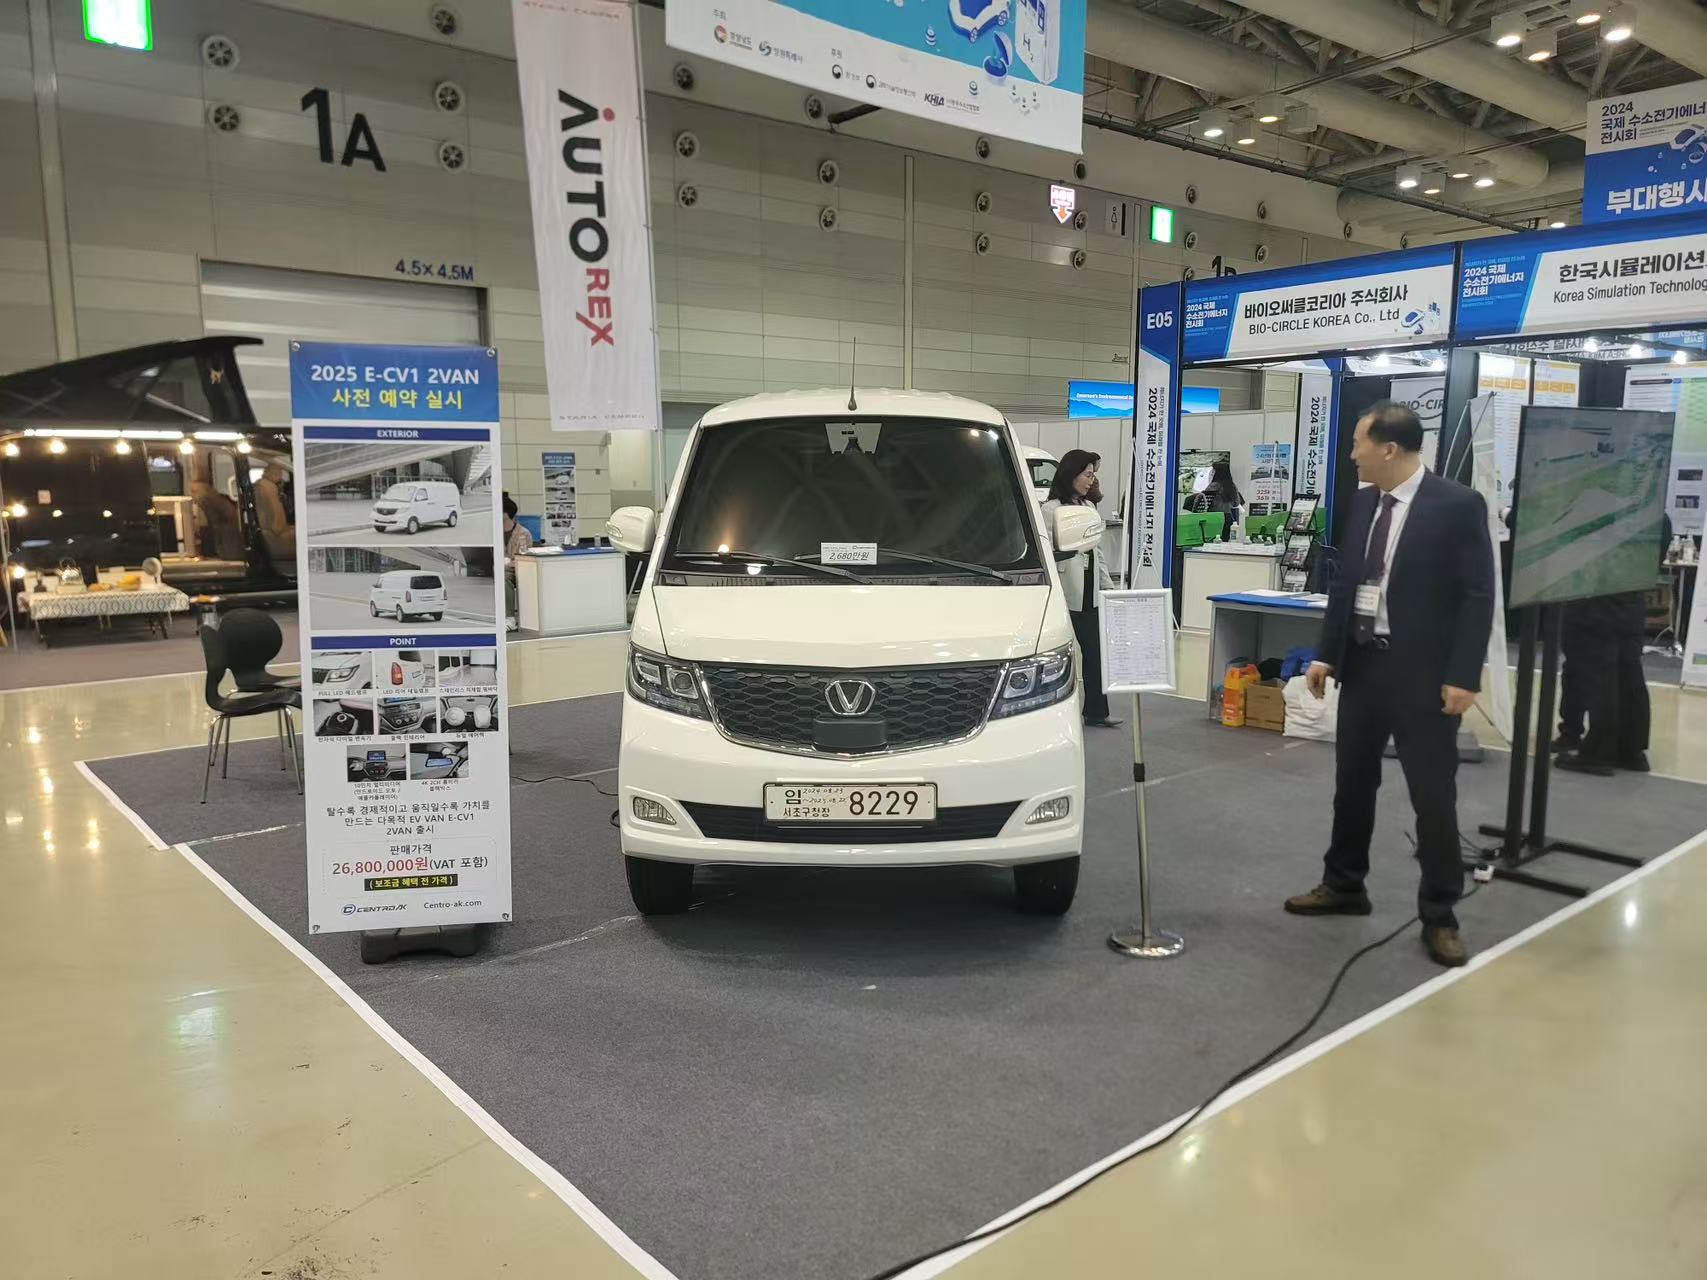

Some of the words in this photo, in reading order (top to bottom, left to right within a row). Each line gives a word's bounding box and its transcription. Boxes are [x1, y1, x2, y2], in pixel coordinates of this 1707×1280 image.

[1601, 101, 1634, 117] 2024
[301, 87, 387, 173] 1A
[1601, 115, 1625, 131] 국제
[1601, 128, 1637, 145] 전시회
[1463, 272, 1524, 287] 수소전기에너지
[1464, 266, 1487, 278] 2024
[1244, 292, 1346, 319] 바이오써클코리아
[1351, 284, 1408, 307] 주식회사
[1553, 290, 1584, 304] Korea
[1587, 283, 1645, 300] Simulation
[1147, 311, 1173, 330] E05
[1186, 308, 1228, 320] 수소전기에너지
[1249, 317, 1309, 335] BIO-CIRCLE
[1313, 314, 1350, 329] KOREA
[1380, 308, 1400, 321] Ltd
[310, 365, 357, 382] 2025
[364, 367, 419, 383] E-CV1
[427, 368, 479, 385] 2VAN
[332, 388, 371, 408] 사전
[379, 388, 418, 409] 예약
[425, 390, 463, 410] 실시
[1148, 387, 1157, 419] 2024
[1310, 396, 1320, 424] 2024
[376, 429, 419, 438] EXTERIOR
[1147, 421, 1157, 445] 국제
[1308, 426, 1319, 446] 국제
[1144, 448, 1156, 529] 수소전기에너지
[829, 552, 869, 561] 2,680만원
[389, 637, 417, 646] POINT
[326, 807, 356, 817] 탈수록
[360, 804, 408, 815] 경제적이고
[411, 802, 459, 813] 움직일수록
[462, 800, 490, 811] 가치를
[785, 789, 801, 804] 임
[849, 790, 918, 816] 8229
[344, 817, 374, 827] 만드는
[377, 815, 406, 826] 다목적
[409, 815, 421, 824] EV
[424, 814, 445, 823] VAN
[448, 813, 475, 822] E-CV1
[386, 827, 412, 836] 2VAN
[416, 824, 434, 835] 출시
[390, 843, 432, 856] 판매가격
[423, 899, 482, 909] Centro-ak.com
